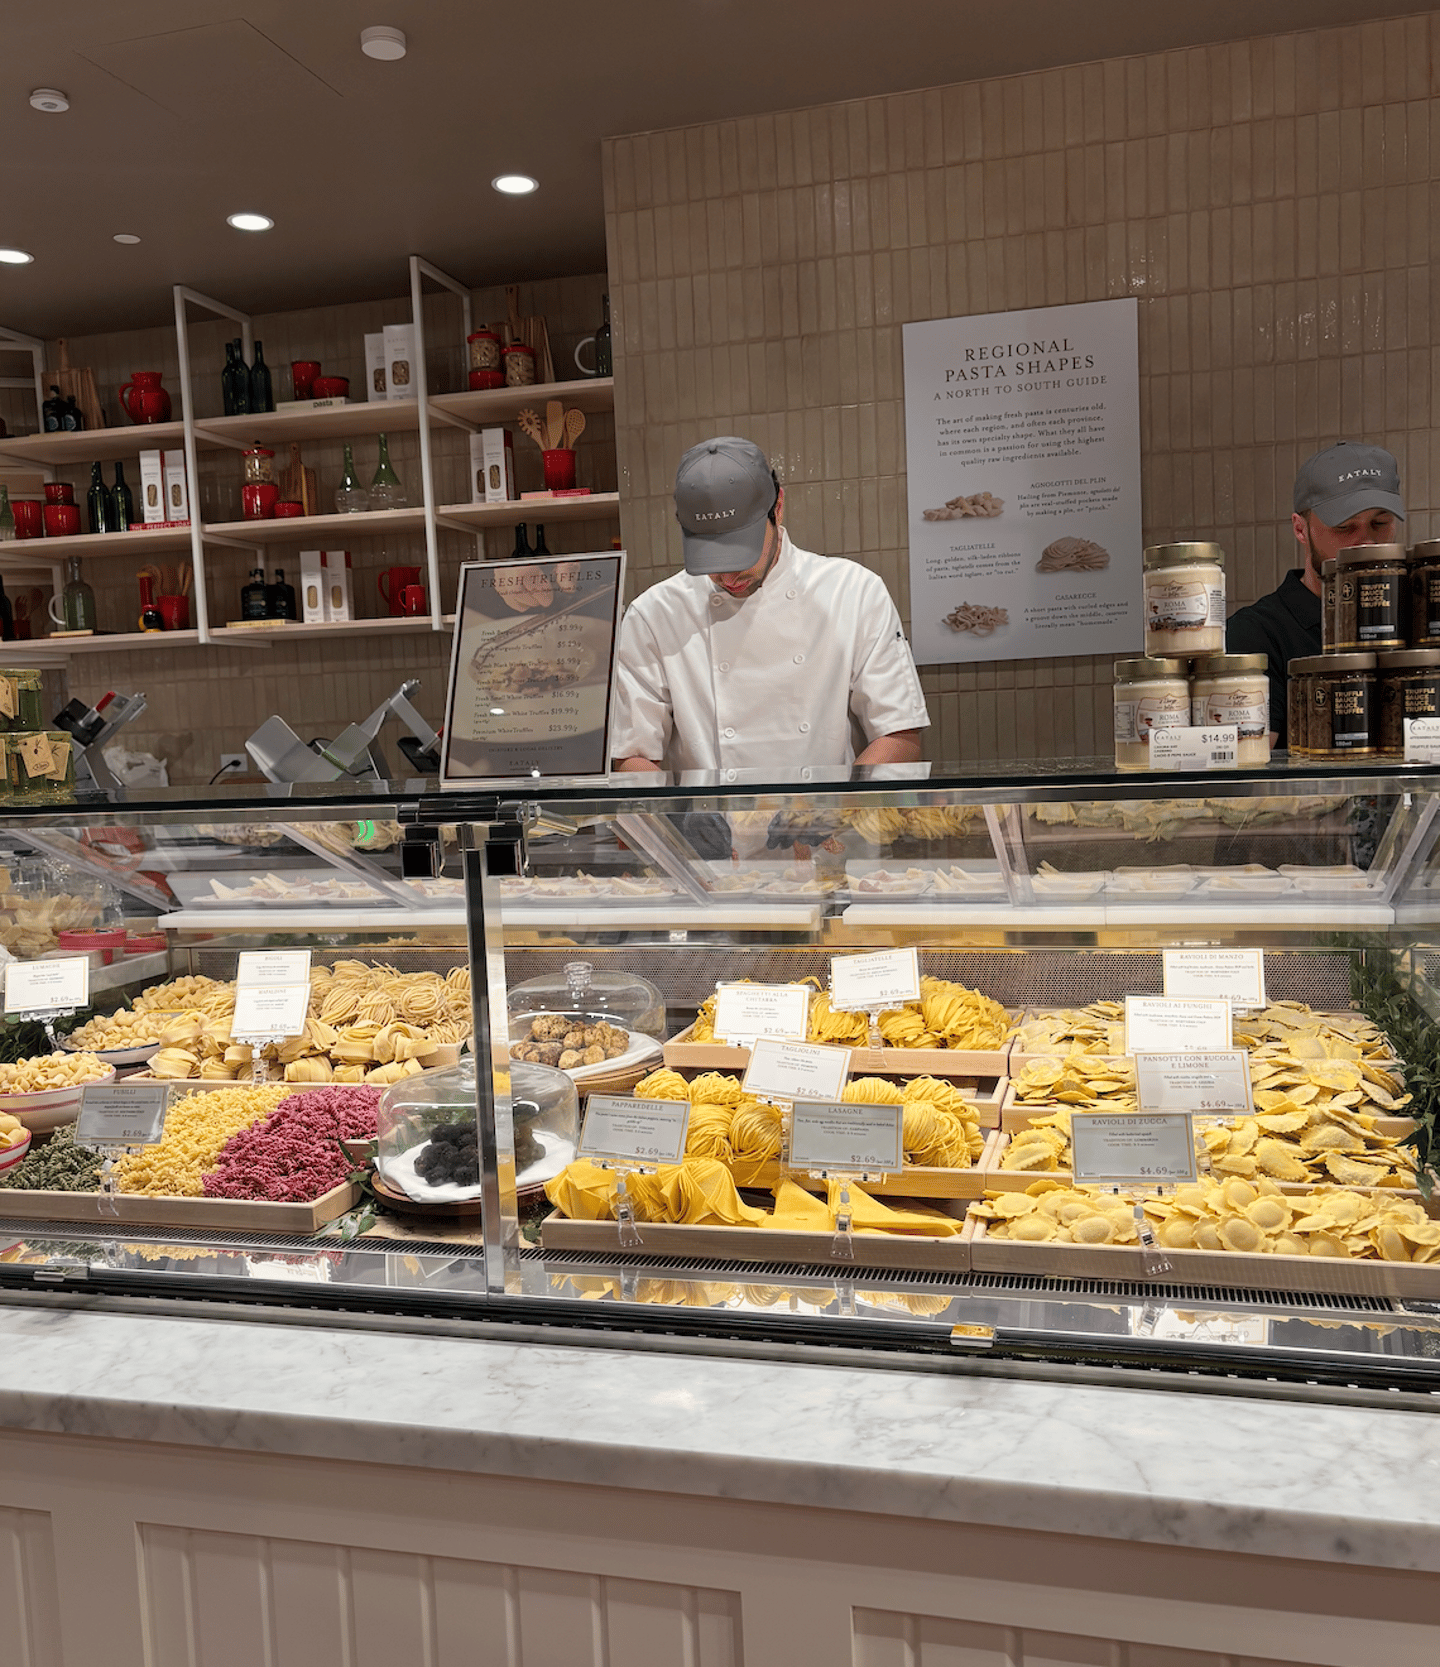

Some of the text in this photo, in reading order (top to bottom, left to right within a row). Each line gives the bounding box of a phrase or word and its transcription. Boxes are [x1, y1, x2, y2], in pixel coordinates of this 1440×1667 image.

[965, 338, 1073, 361] REGIONAL
[946, 354, 1094, 382] PASTA SHAPES
[934, 375, 1106, 400] A NORTH TO SOUTH GUIDE
[974, 413, 1002, 422] making
[1004, 410, 1022, 418] fresh
[1024, 410, 1044, 419] pasta
[1054, 406, 1089, 414] centuries
[963, 425, 979, 433] each
[1026, 419, 1046, 427] often
[1048, 417, 1065, 425] each
[978, 433, 1010, 444] specialty
[1012, 432, 1036, 440] shape.
[1059, 428, 1075, 438] they
[1077, 426, 1087, 434] all
[997, 443, 1025, 454] passion
[1077, 436, 1104, 445] highest
[960, 457, 986, 467] quality
[1002, 452, 1045, 463] ingredients
[1046, 448, 1081, 457] available.
[1338, 469, 1382, 482] EATALY
[1030, 479, 1073, 489] AGNOLOTTI
[695, 508, 736, 520] EATALY
[949, 542, 995, 552] TAGLIATELLE
[481, 571, 602, 588] FRESH TRUFFLES
[1055, 592, 1096, 600] CASARECCE
[1202, 734, 1235, 743] $14.99
[854, 956, 892, 964] TAGLIATELLE
[782, 1045, 820, 1055] TAGLIOLINI
[796, 1086, 818, 1095] $2.69
[635, 1146, 658, 1156] $2.69
[851, 1155, 876, 1163] $2.69
[1140, 1167, 1167, 1175] $4.69
